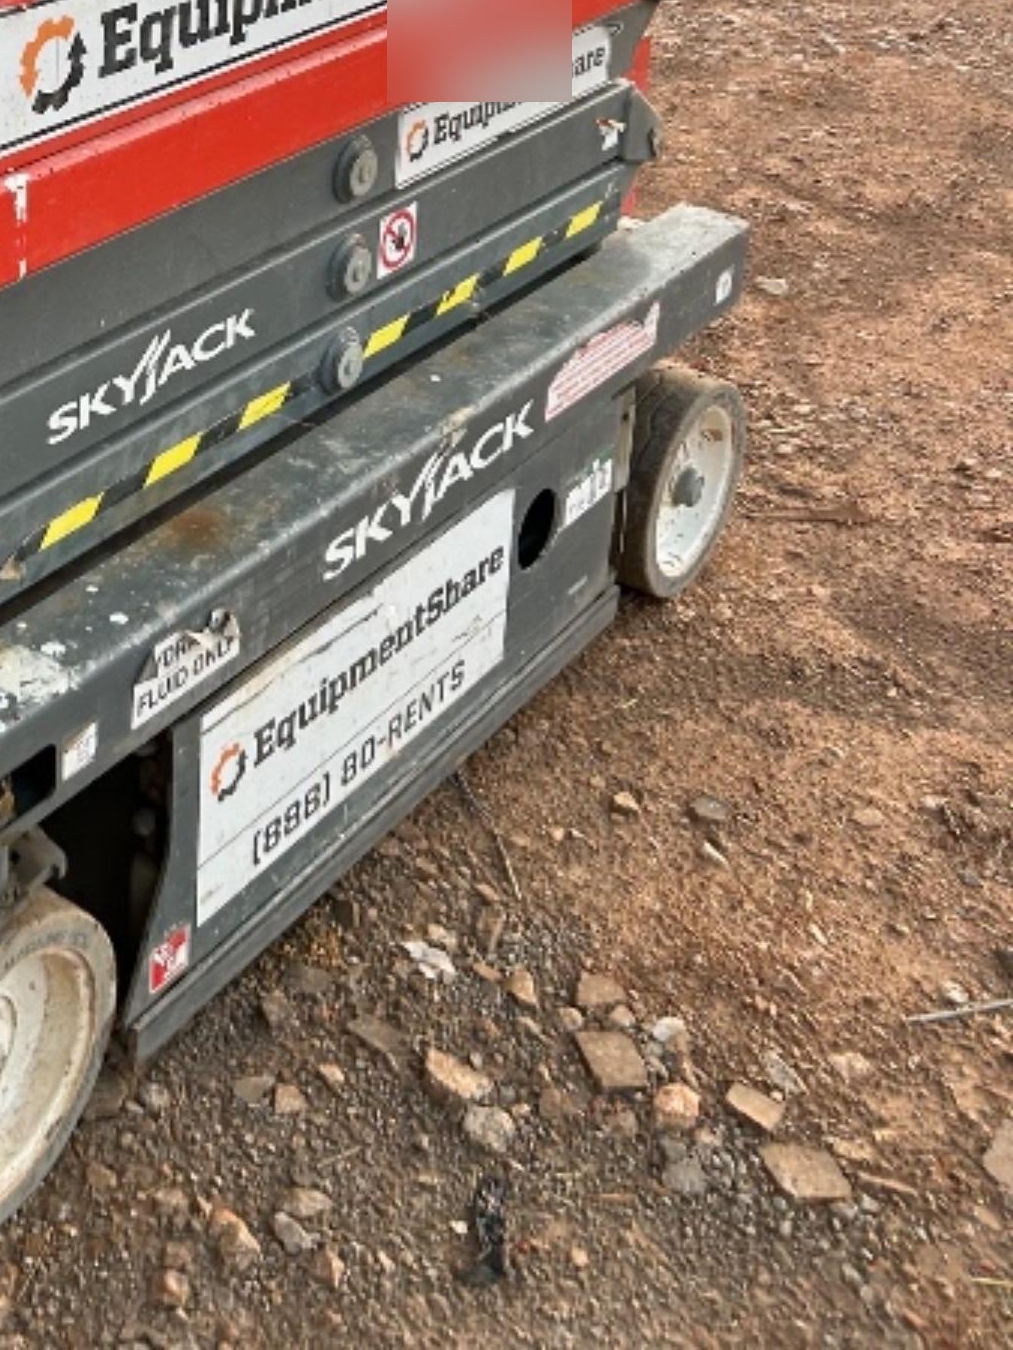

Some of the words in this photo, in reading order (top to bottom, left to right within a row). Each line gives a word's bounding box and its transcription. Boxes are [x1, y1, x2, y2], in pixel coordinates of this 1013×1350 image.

[46, 307, 256, 446] SKYJACK
[323, 401, 534, 582] SKYJACK
[252, 544, 505, 770] EquipmentShare
[252, 771, 332, 867] (888)
[341, 658, 466, 788] 80-RENTS
